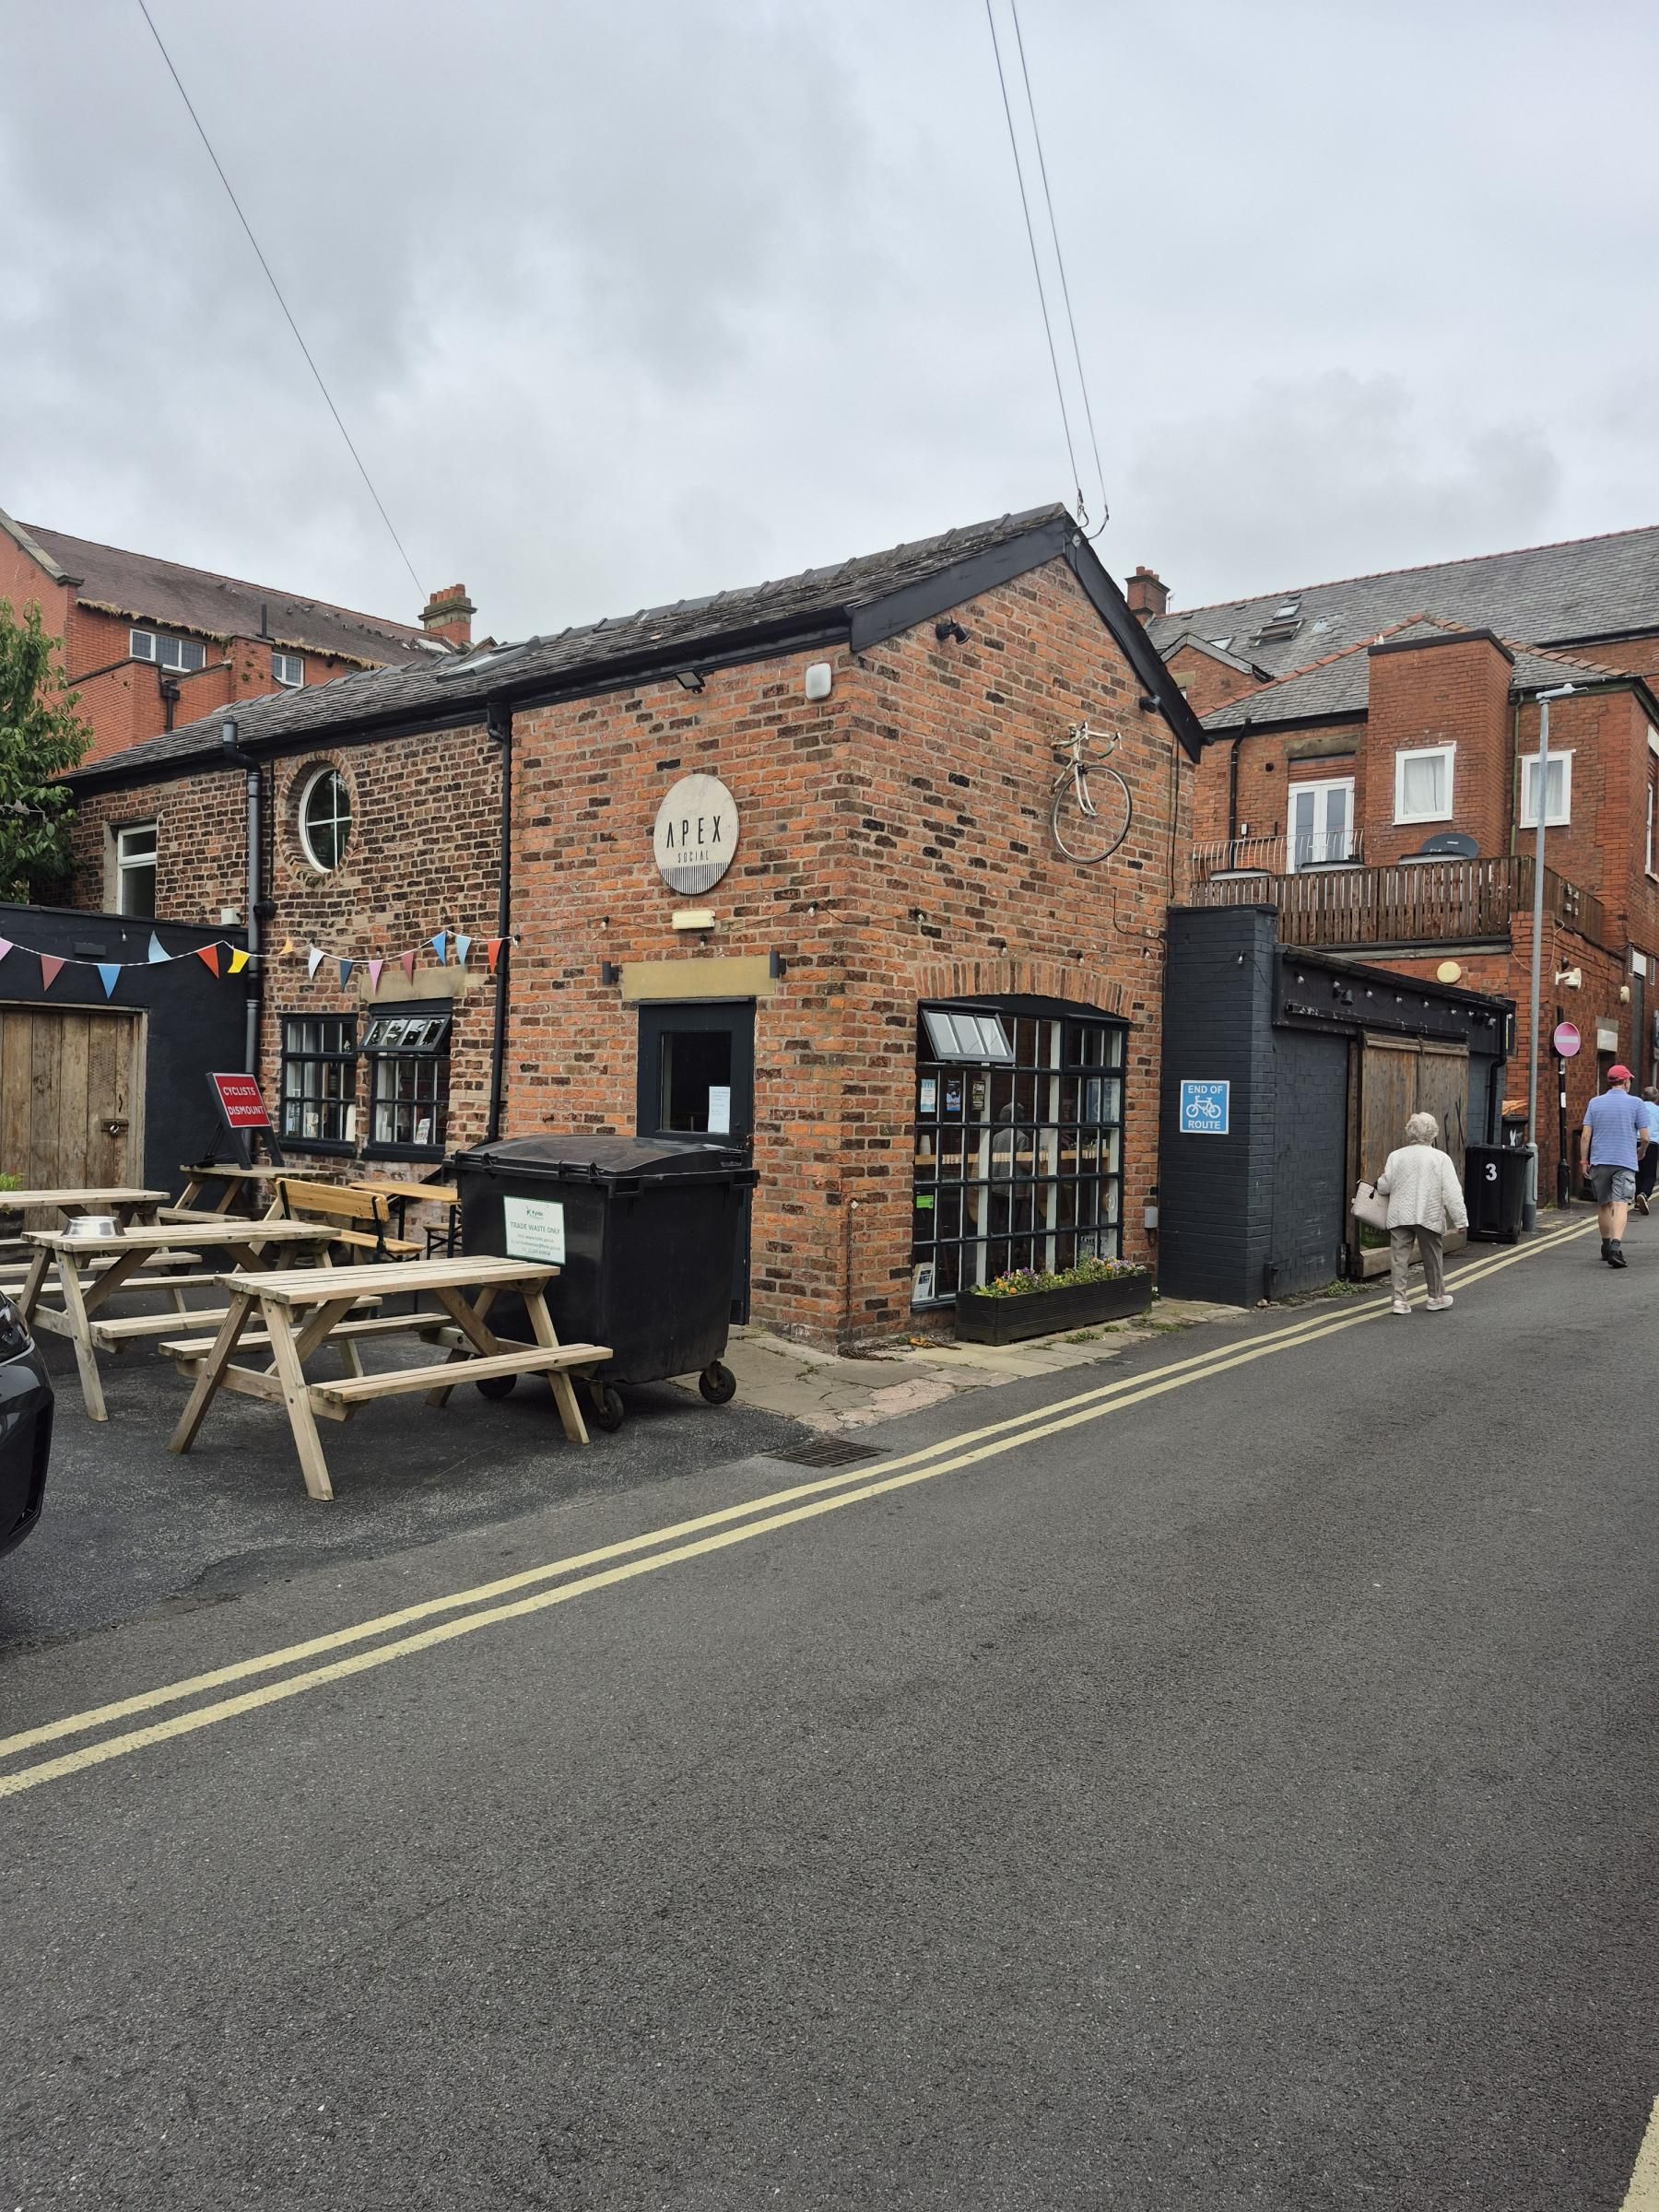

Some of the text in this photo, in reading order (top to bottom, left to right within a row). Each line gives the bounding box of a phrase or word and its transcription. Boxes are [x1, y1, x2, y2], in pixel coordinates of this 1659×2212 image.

[666, 816, 721, 848] APEX
[677, 850, 709, 864] SOCIAL
[223, 1087, 256, 1096] CYCLISTS
[1187, 1085, 1223, 1094] END OF
[227, 1106, 265, 1115] DISMOUNT
[1188, 1120, 1221, 1130] ROUTE
[1486, 1163, 1498, 1182] 3
[510, 1221, 560, 1235] TRADE WASTE ONLY
